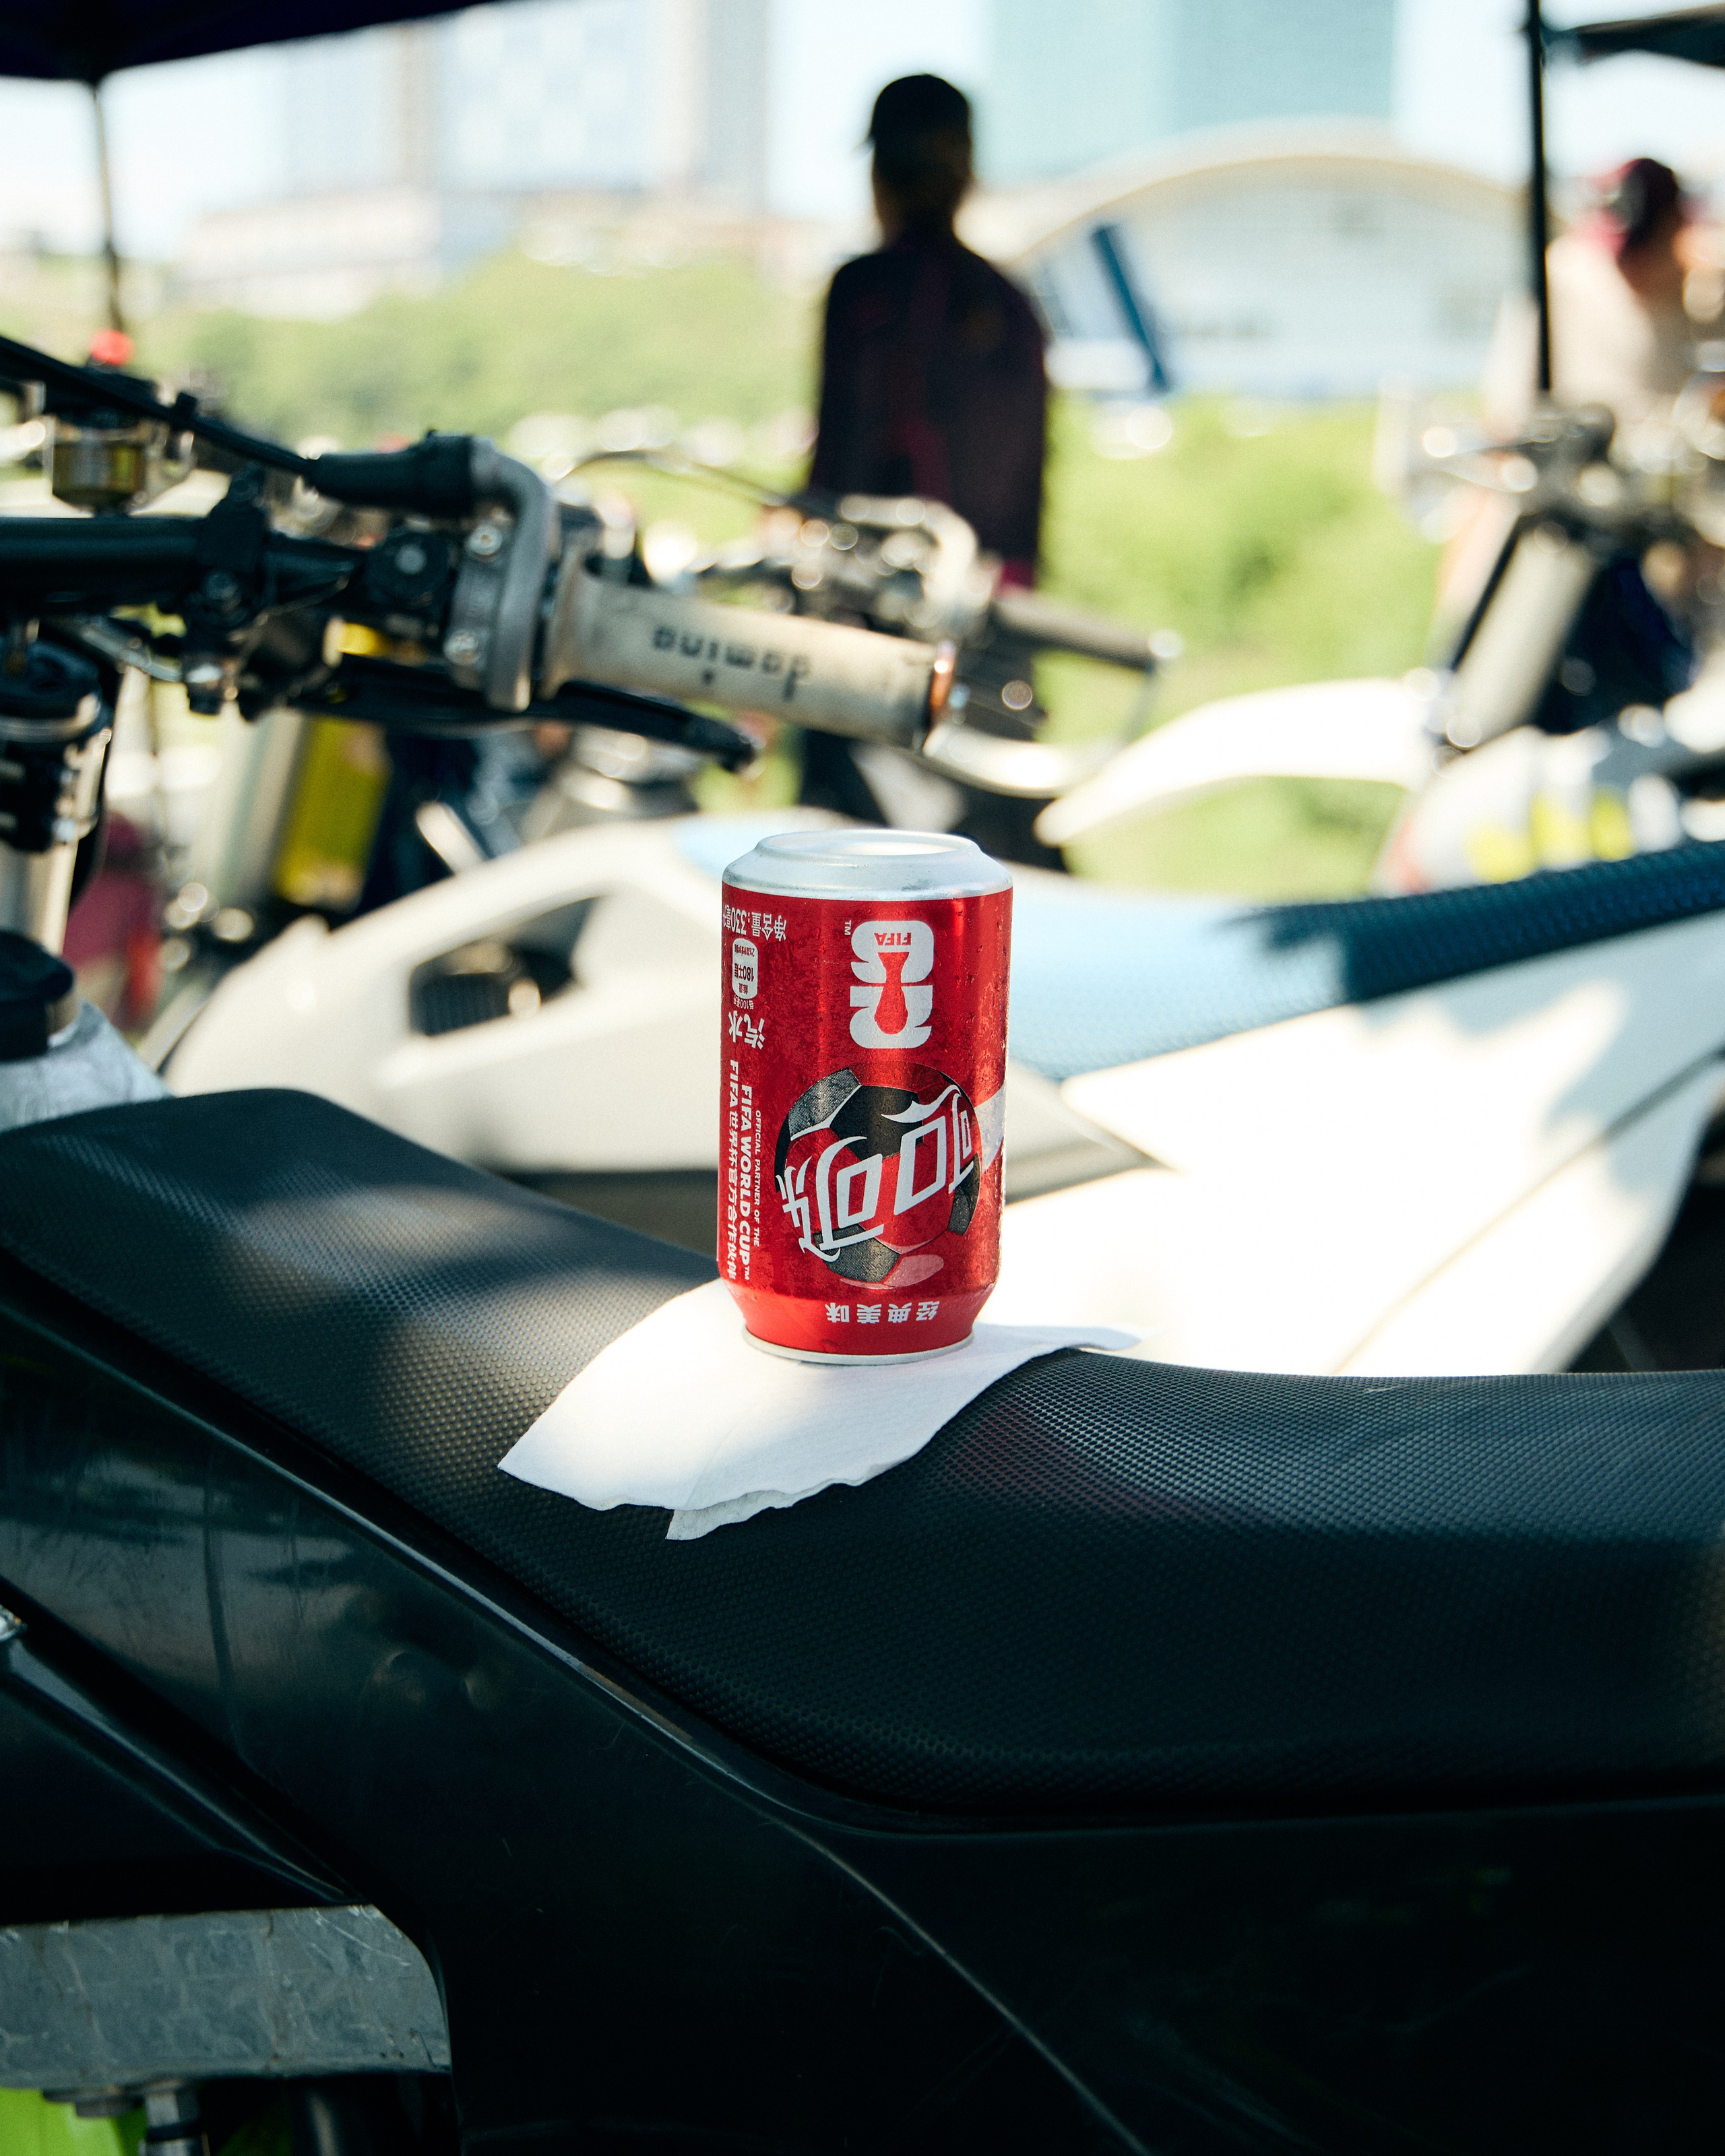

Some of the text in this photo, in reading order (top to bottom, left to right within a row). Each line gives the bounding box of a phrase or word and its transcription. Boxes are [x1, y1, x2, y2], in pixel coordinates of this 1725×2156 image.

[875, 931, 912, 945] FIFA
[728, 1011, 765, 1050] 汽水
[741, 1085, 752, 1132] FIFA
[726, 1060, 739, 1279] FIFA 世界杯官方合作伙伴
[740, 1136, 751, 1219] WORLD
[776, 1085, 974, 1263] 可口可乐
[753, 1209, 760, 1224] OF
[824, 1300, 940, 1324] 经典美味
